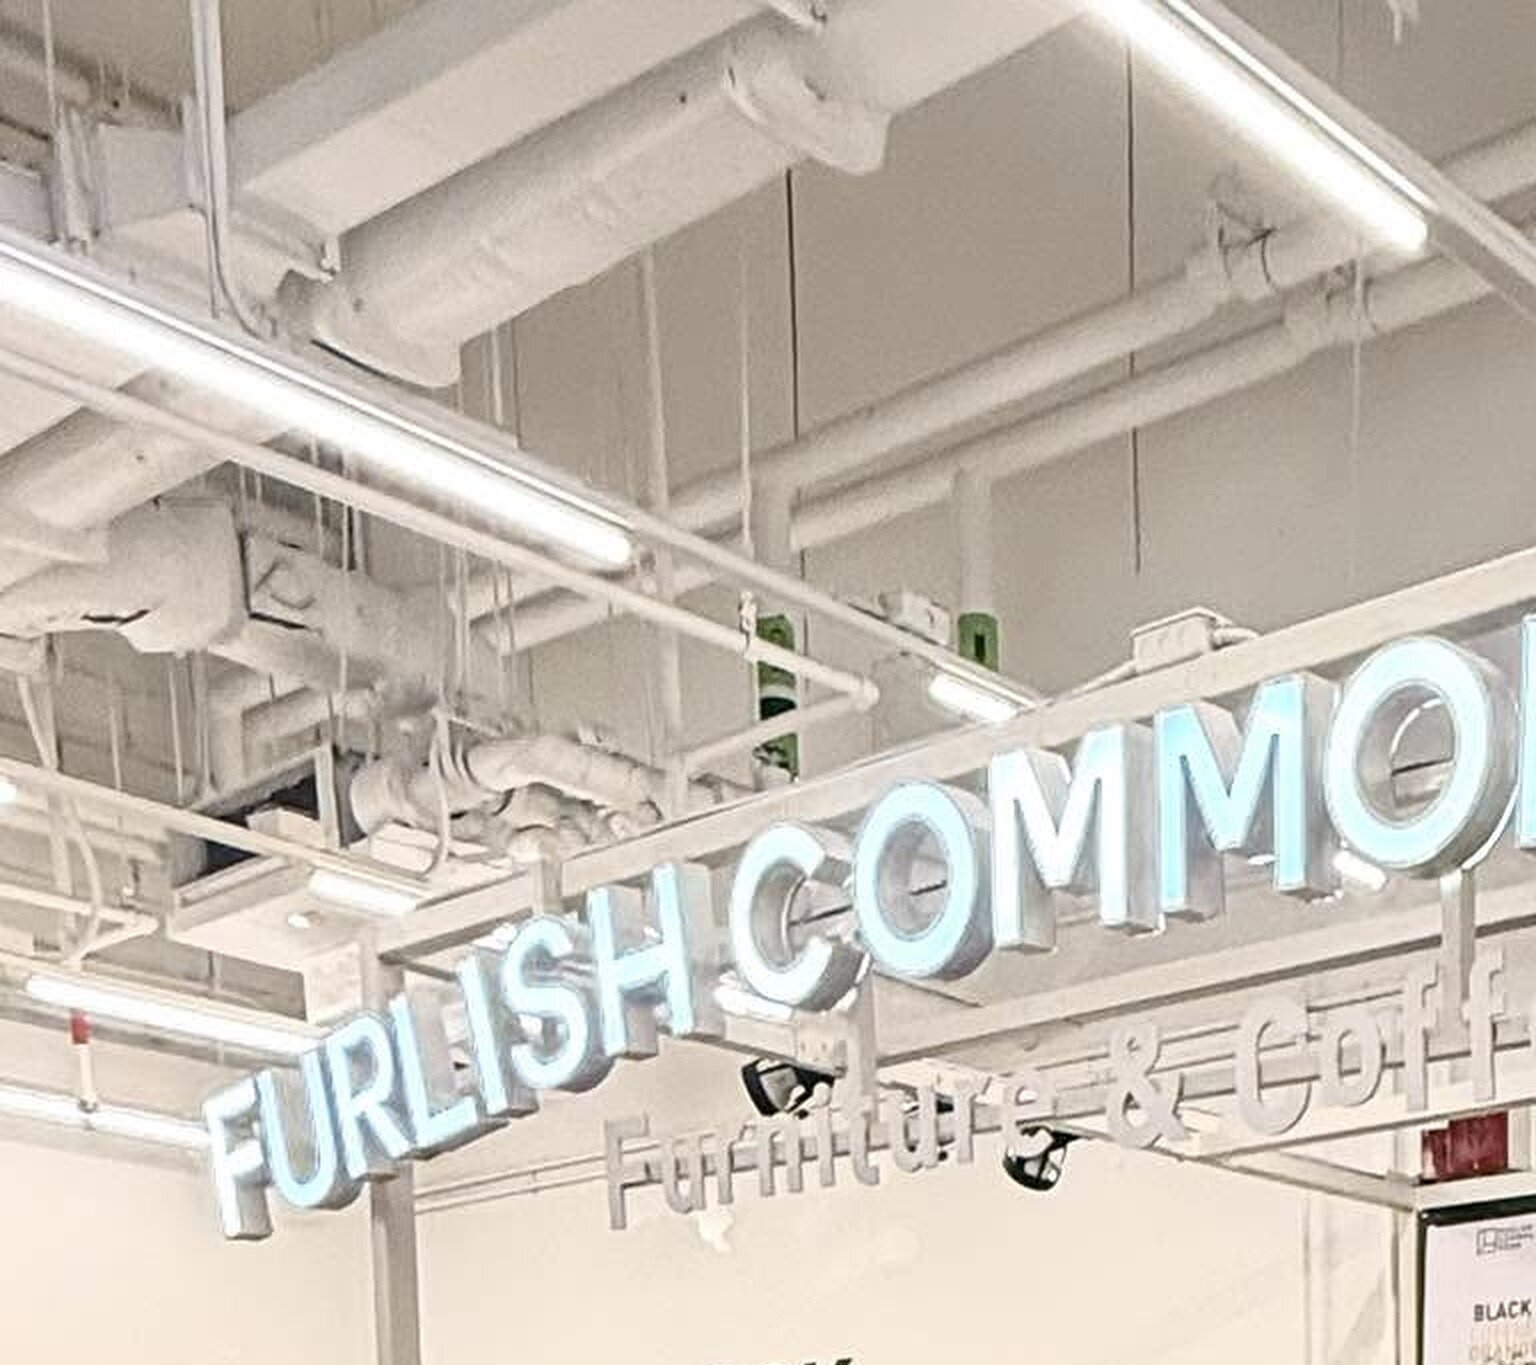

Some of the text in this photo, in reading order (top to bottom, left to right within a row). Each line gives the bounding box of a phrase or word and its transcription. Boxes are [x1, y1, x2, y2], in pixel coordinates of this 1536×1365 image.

[203, 863, 700, 1240] FURLISH
[602, 1036, 1058, 1231] Furniture
[1104, 1016, 1192, 1150] &
[1473, 1298, 1533, 1323] BLACK
